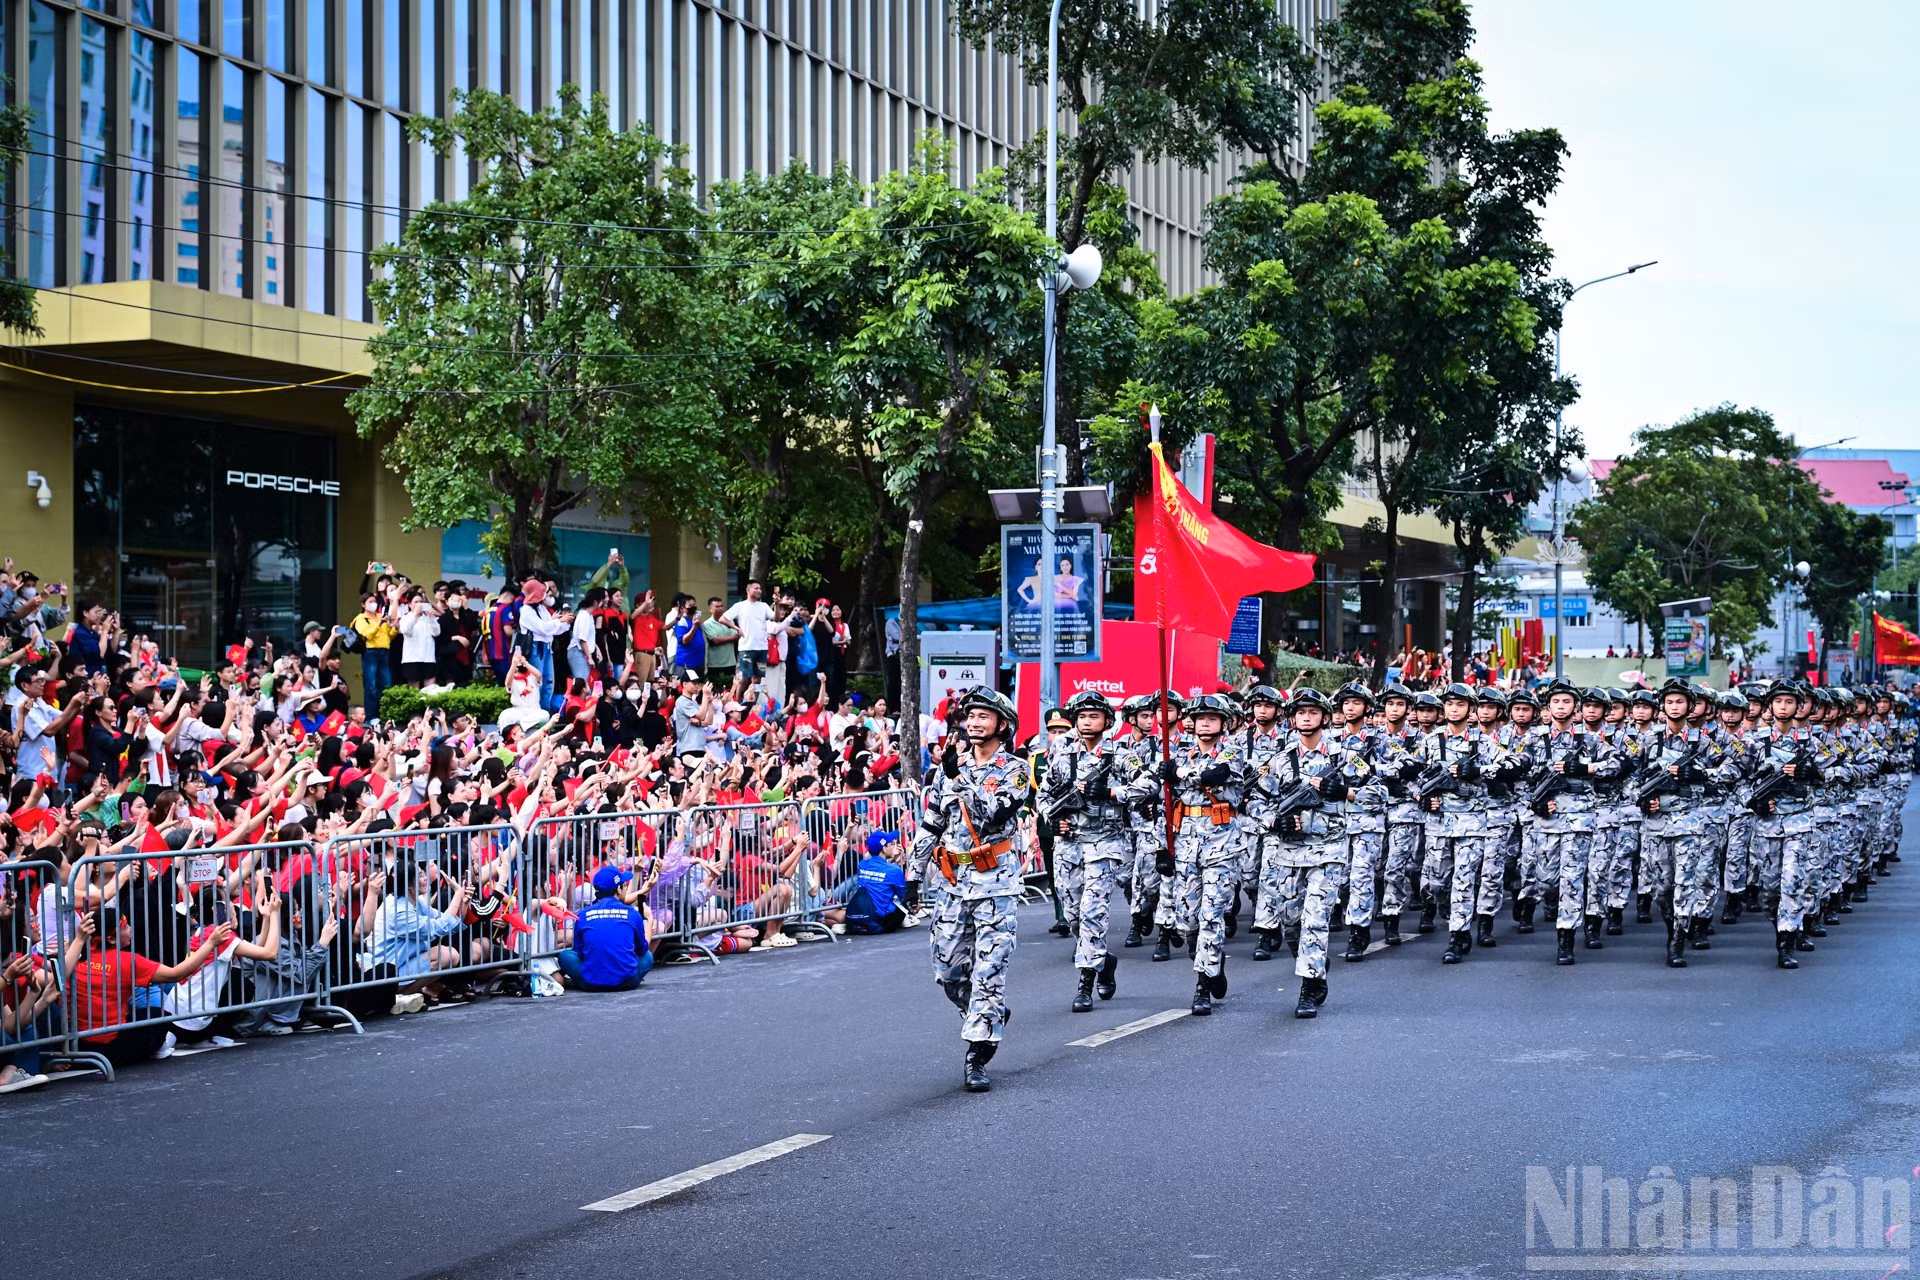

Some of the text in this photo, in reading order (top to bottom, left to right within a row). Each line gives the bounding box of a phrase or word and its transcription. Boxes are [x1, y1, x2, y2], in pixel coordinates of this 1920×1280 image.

[226, 469, 341, 497] PORSCHE
[1073, 678, 1126, 693] viettel
[193, 869, 212, 878] STOP
